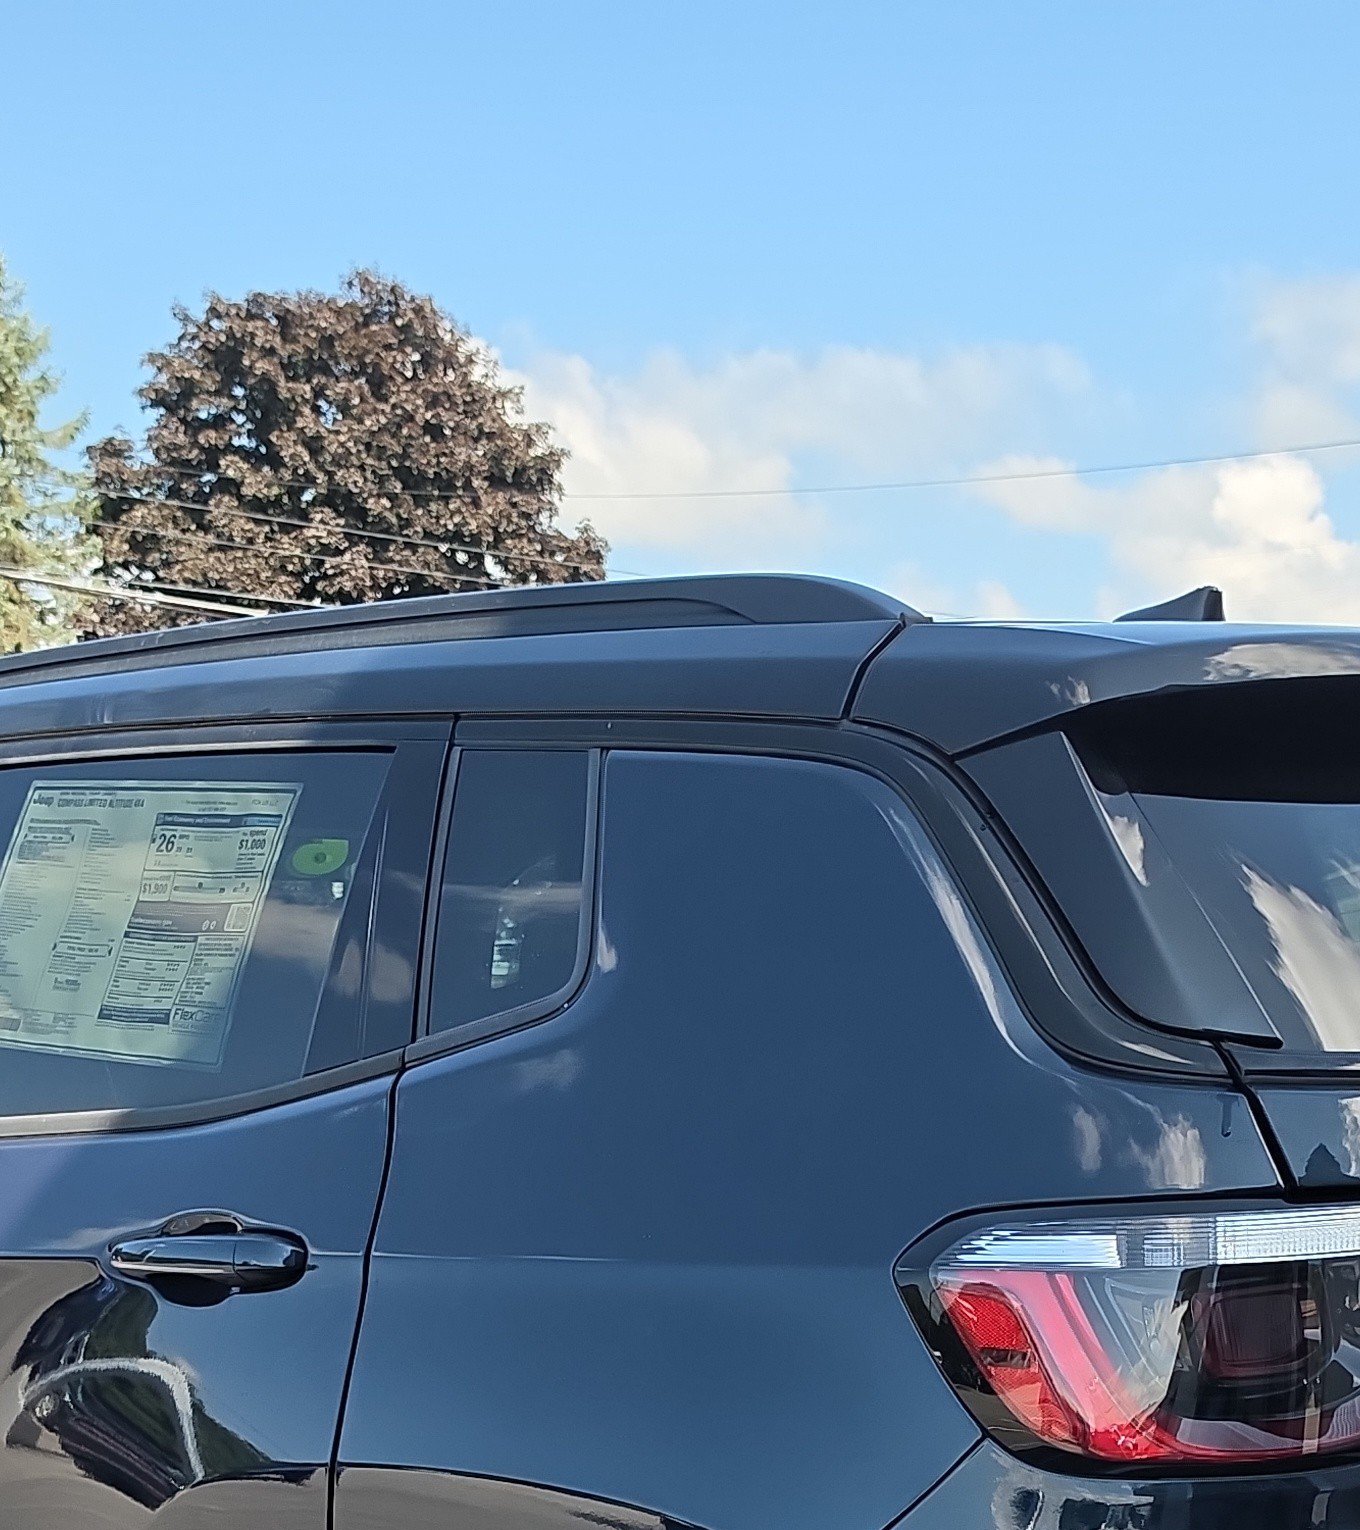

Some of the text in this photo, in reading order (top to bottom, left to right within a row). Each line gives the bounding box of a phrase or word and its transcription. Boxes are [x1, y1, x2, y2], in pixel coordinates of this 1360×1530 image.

[156, 833, 177, 853] 26
[238, 839, 267, 851] $1,000
[142, 883, 168, 895] $1,900
